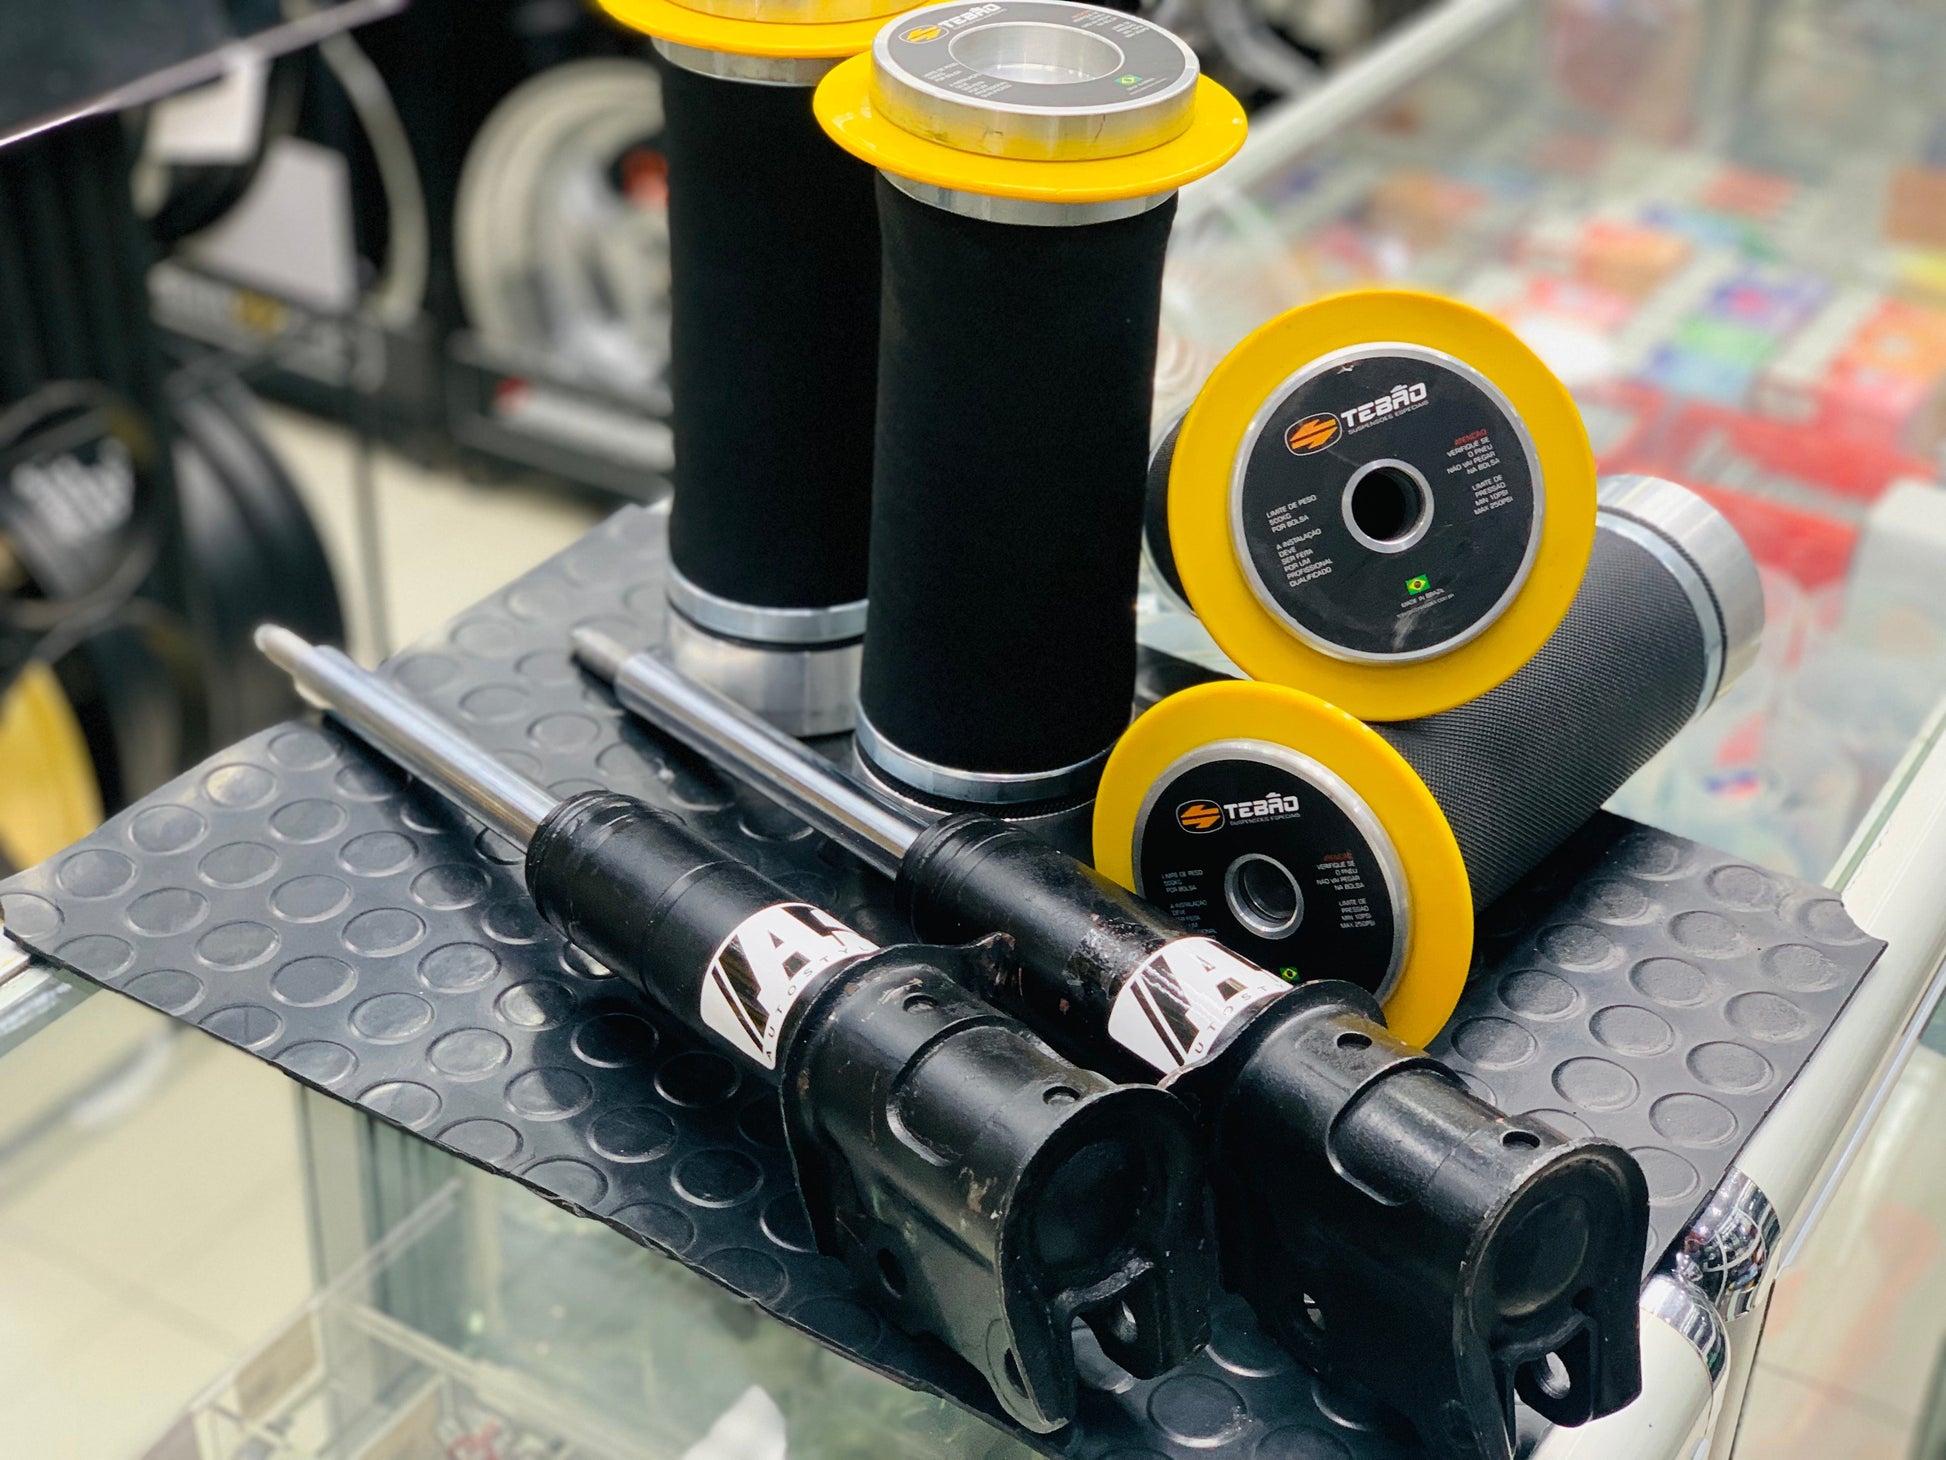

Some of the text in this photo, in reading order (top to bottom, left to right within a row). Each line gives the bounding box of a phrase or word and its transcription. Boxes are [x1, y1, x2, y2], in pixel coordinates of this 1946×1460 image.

[1446, 436, 1490, 457] VERIFIQUE SE
[1467, 444, 1493, 458] O PNEU
[1474, 451, 1496, 464] PEGAR
[1478, 458, 1501, 471] BOLSA
[1472, 478, 1492, 491] LIMITE
[1266, 495, 1317, 518] LIMITE DE PESO
[1474, 497, 1489, 506] MIN
[1473, 505, 1489, 515] MAX
[1271, 515, 1309, 533] POR BOLSA
[1282, 528, 1322, 548] INSTALAÇÃO
[1278, 547, 1297, 558] DEVE
[1281, 549, 1314, 565] SER FEITA
[1284, 558, 1311, 572] POR UM
[1286, 558, 1333, 580] PROFISSIONAL
[1289, 567, 1332, 587] QUALIFICADO
[765, 946, 869, 1062] AUTOSTYL
